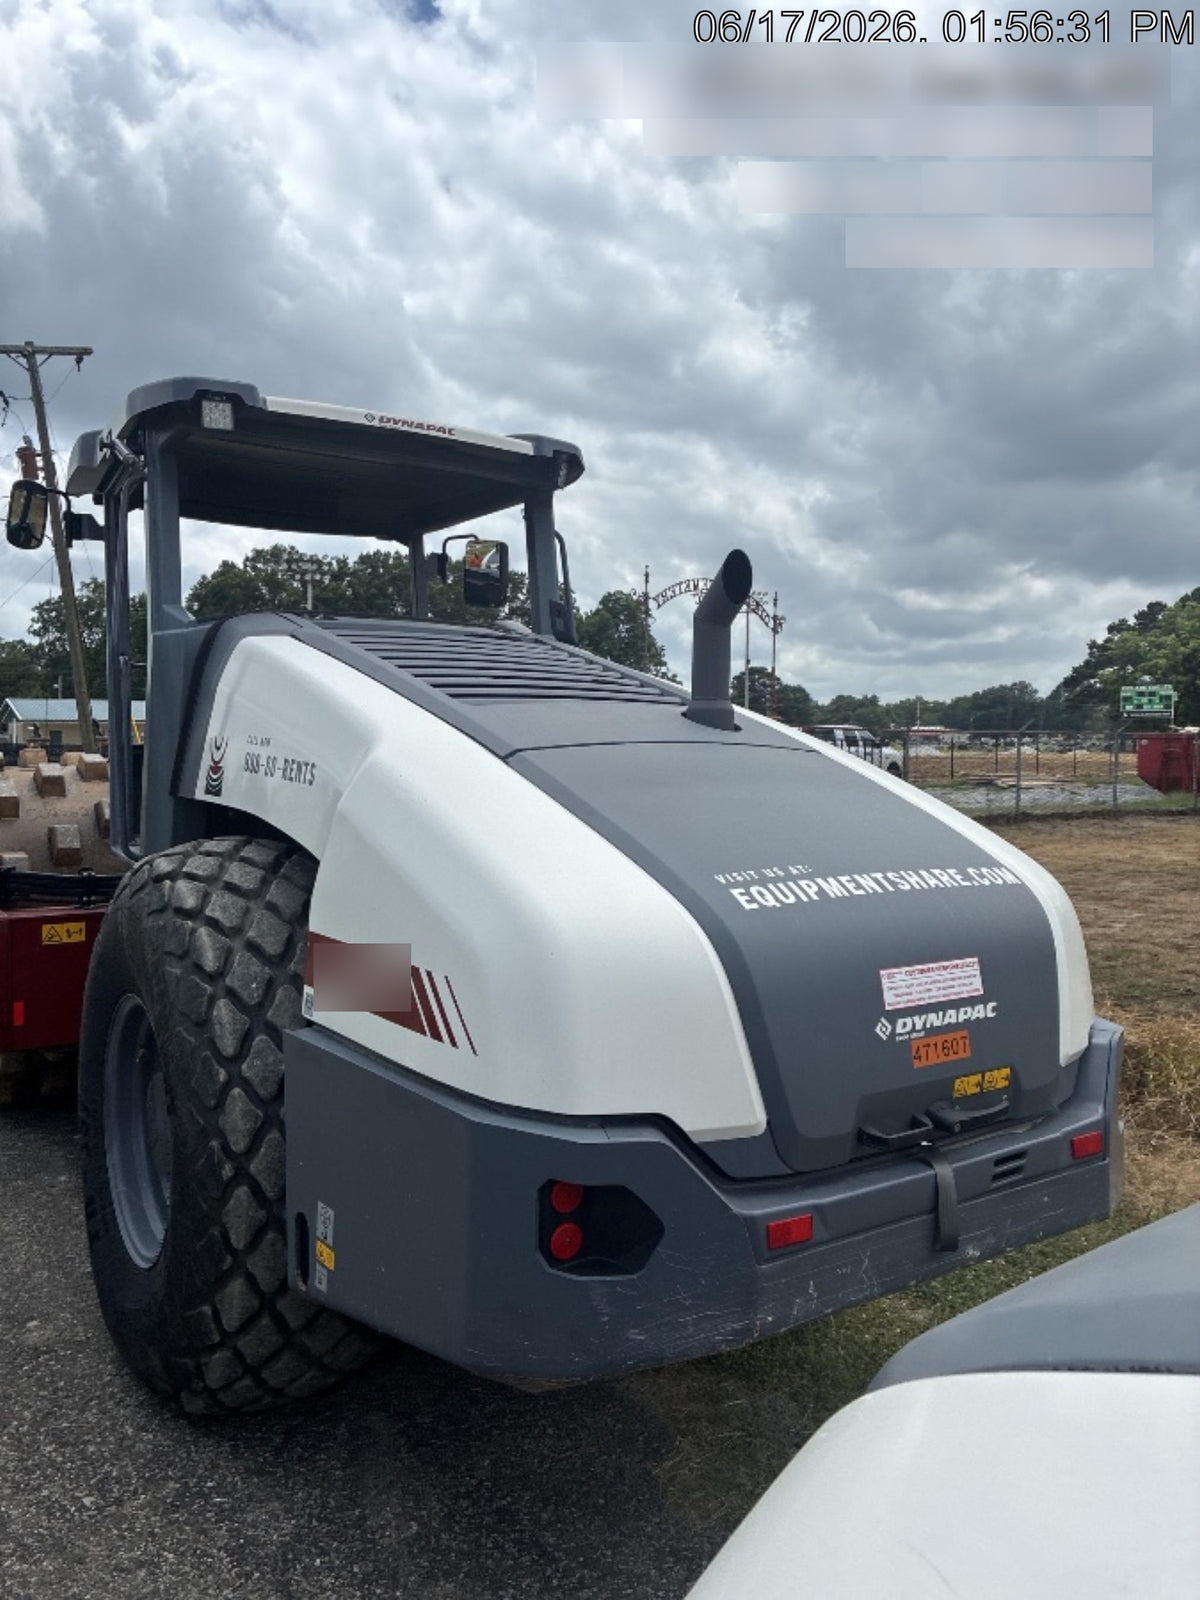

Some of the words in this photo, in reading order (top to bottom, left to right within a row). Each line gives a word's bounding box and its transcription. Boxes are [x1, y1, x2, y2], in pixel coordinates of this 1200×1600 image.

[378, 415, 456, 436] DYNAPAC
[713, 870, 759, 884] VISIT
[761, 867, 785, 878] US
[787, 864, 813, 876] AT:
[729, 866, 1023, 911] EQUIPMENTSHARE.COM
[895, 1002, 998, 1034] DYNAPAC
[913, 1036, 968, 1063] 471607
